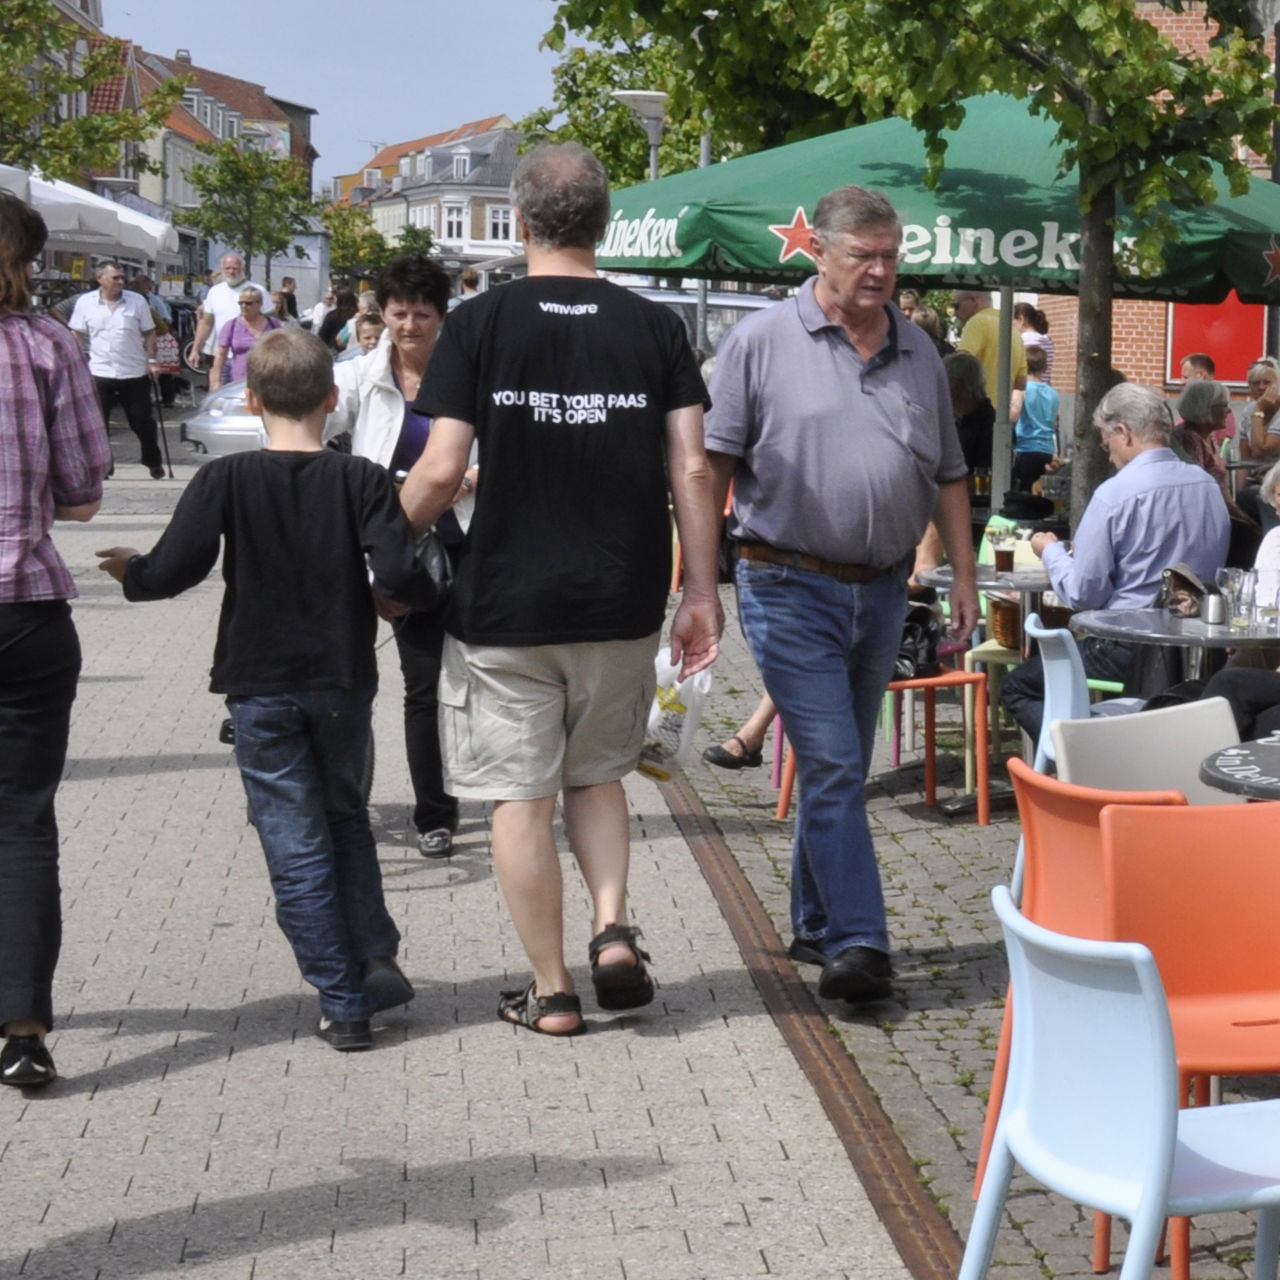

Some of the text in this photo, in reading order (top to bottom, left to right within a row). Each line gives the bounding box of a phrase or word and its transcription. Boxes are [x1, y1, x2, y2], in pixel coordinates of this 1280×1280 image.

[596, 207, 683, 258] ineken
[899, 214, 1163, 278] einek
[539, 301, 598, 316] vmware
[492, 390, 647, 410] YOU BET YOUR PAAS
[534, 407, 606, 425] IT'S OPEN
